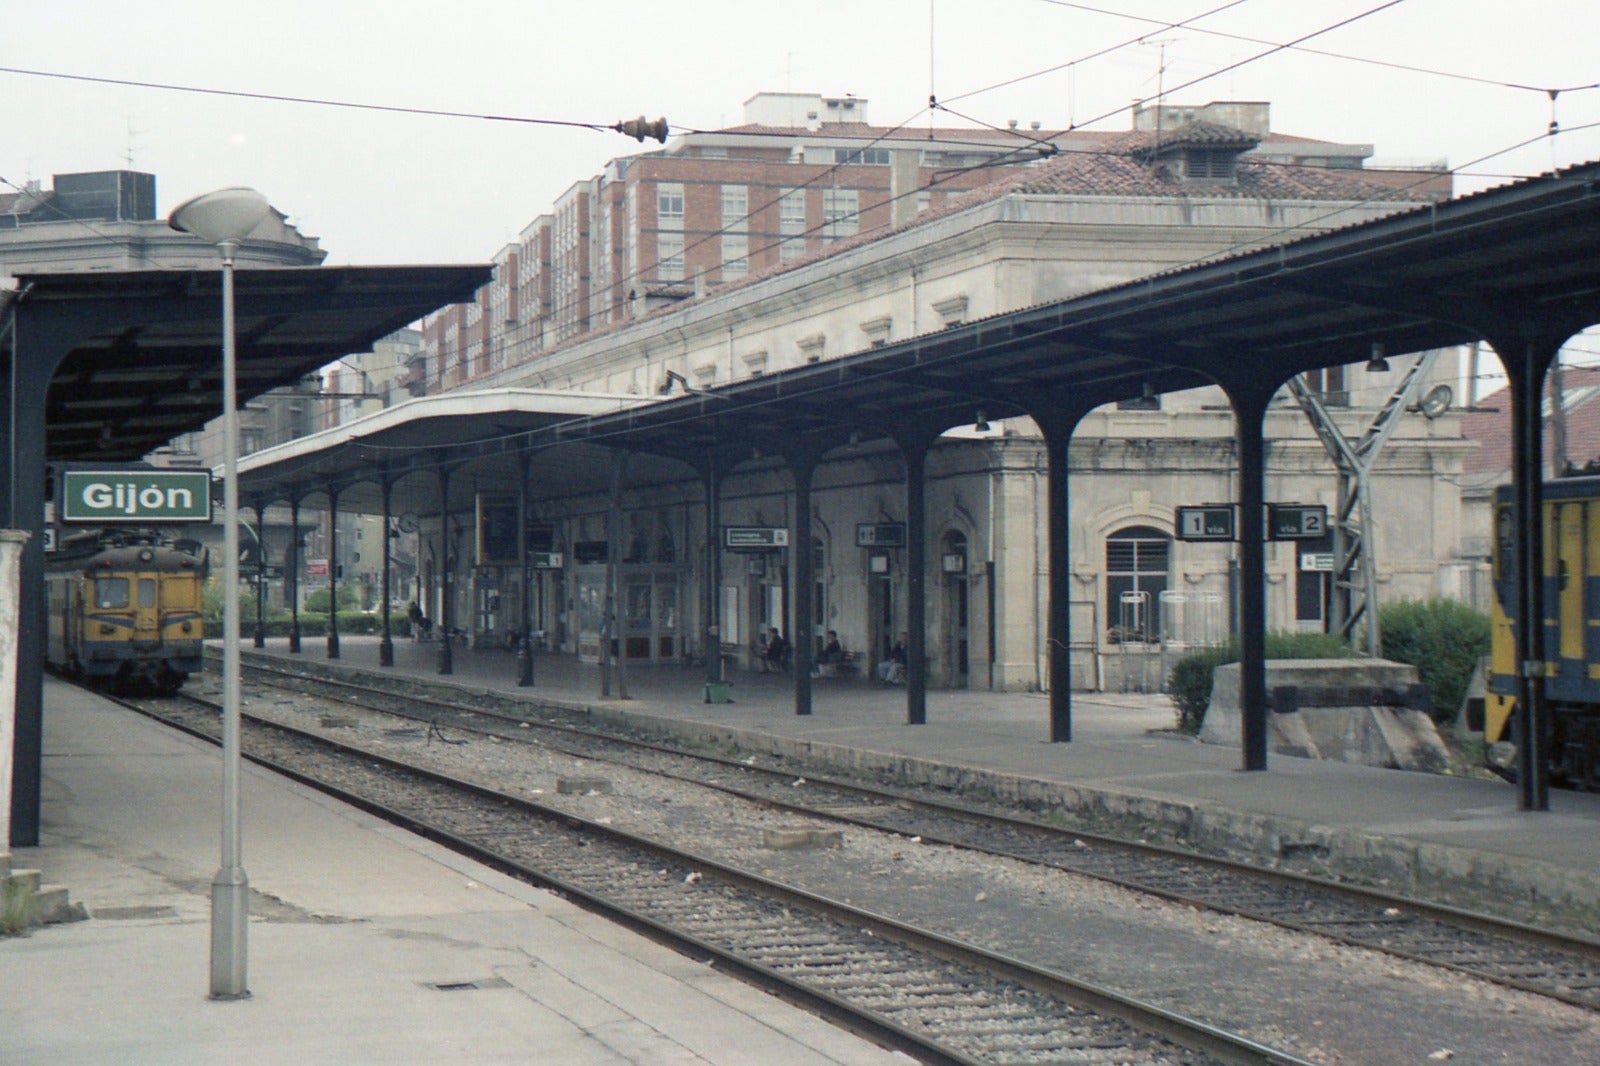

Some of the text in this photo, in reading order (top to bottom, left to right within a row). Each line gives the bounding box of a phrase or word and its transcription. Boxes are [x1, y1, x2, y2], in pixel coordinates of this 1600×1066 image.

[82, 483, 193, 514] Gijón
[1193, 517, 1200, 531] 1
[1305, 516, 1319, 530] 2
